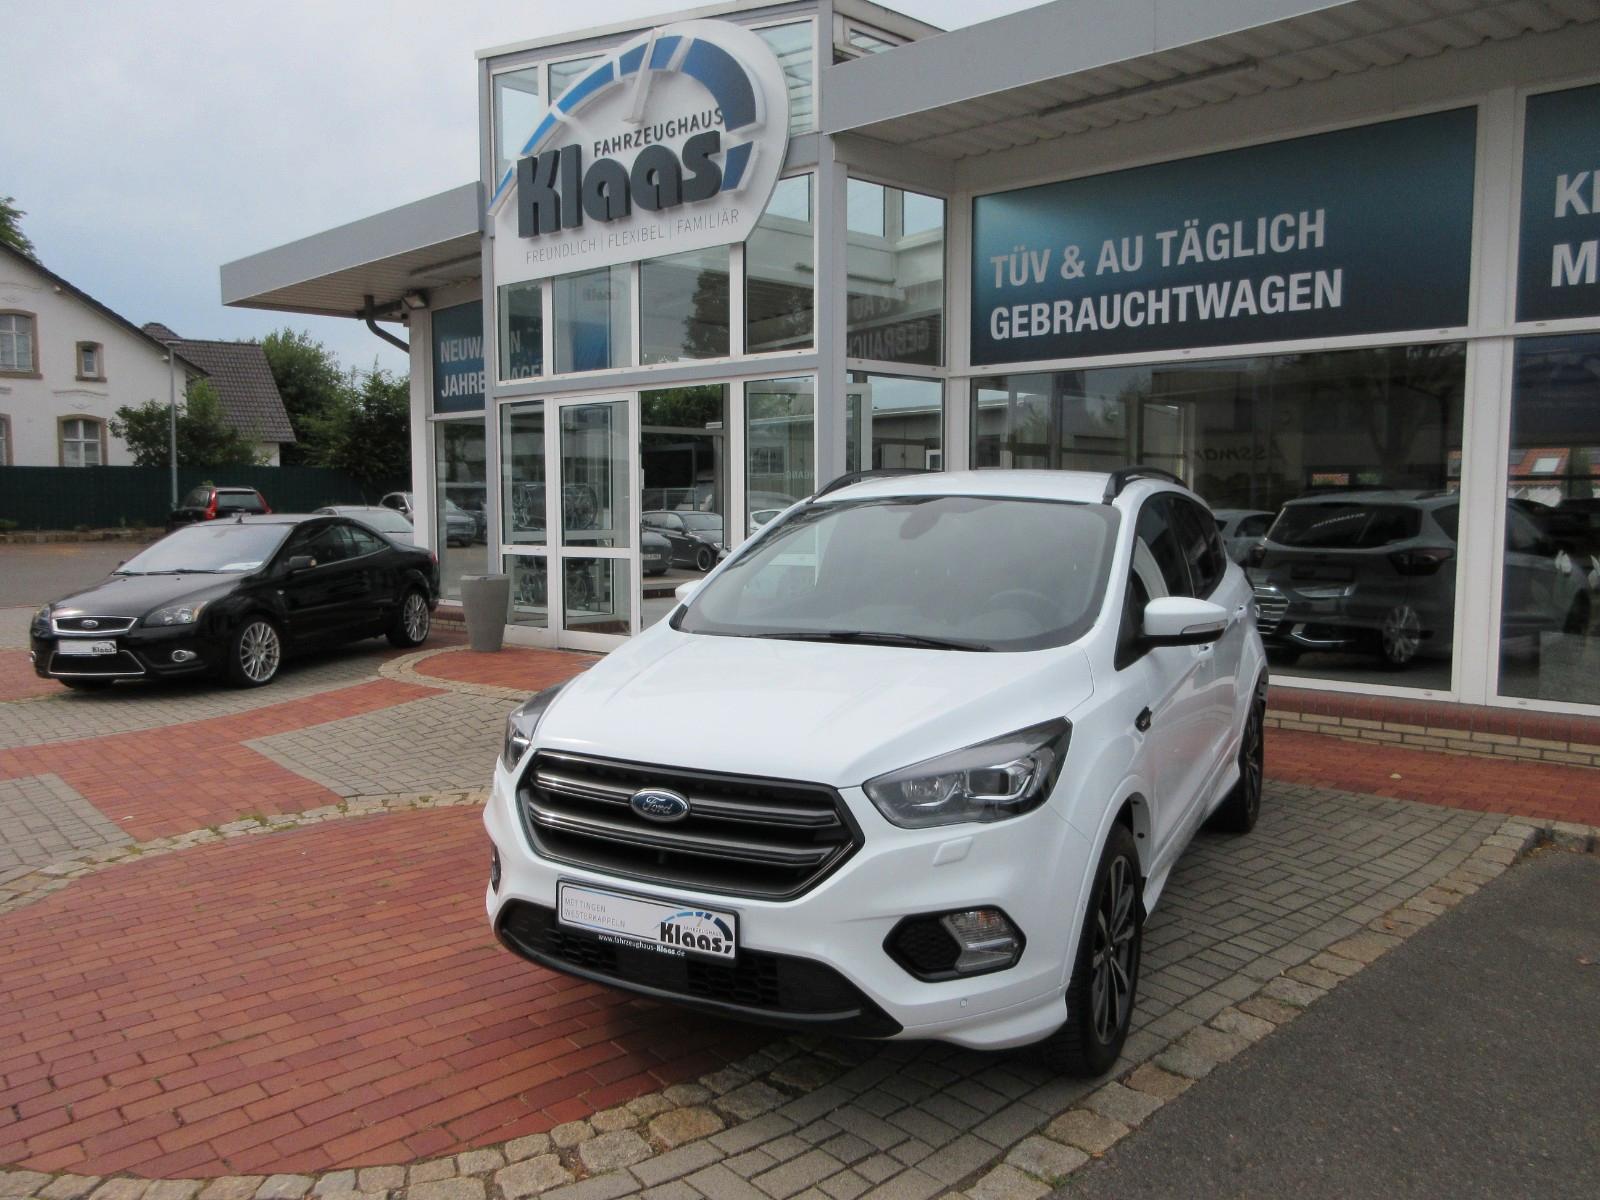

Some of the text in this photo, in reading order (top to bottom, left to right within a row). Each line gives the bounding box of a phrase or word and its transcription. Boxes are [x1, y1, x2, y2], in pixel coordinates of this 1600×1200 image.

[593, 107, 724, 158] FAHRZEUGHAUS
[517, 130, 723, 239] Klaas
[526, 208, 740, 265] FREUNDLICH FLEXIBEL FAMILIÄR
[990, 208, 1326, 289] TÜV & AU TÄGLICH
[989, 269, 1344, 341] GEBRAUCHTWAGEN
[565, 898, 606, 913] METTINGEN
[660, 921, 723, 953] Klaas
